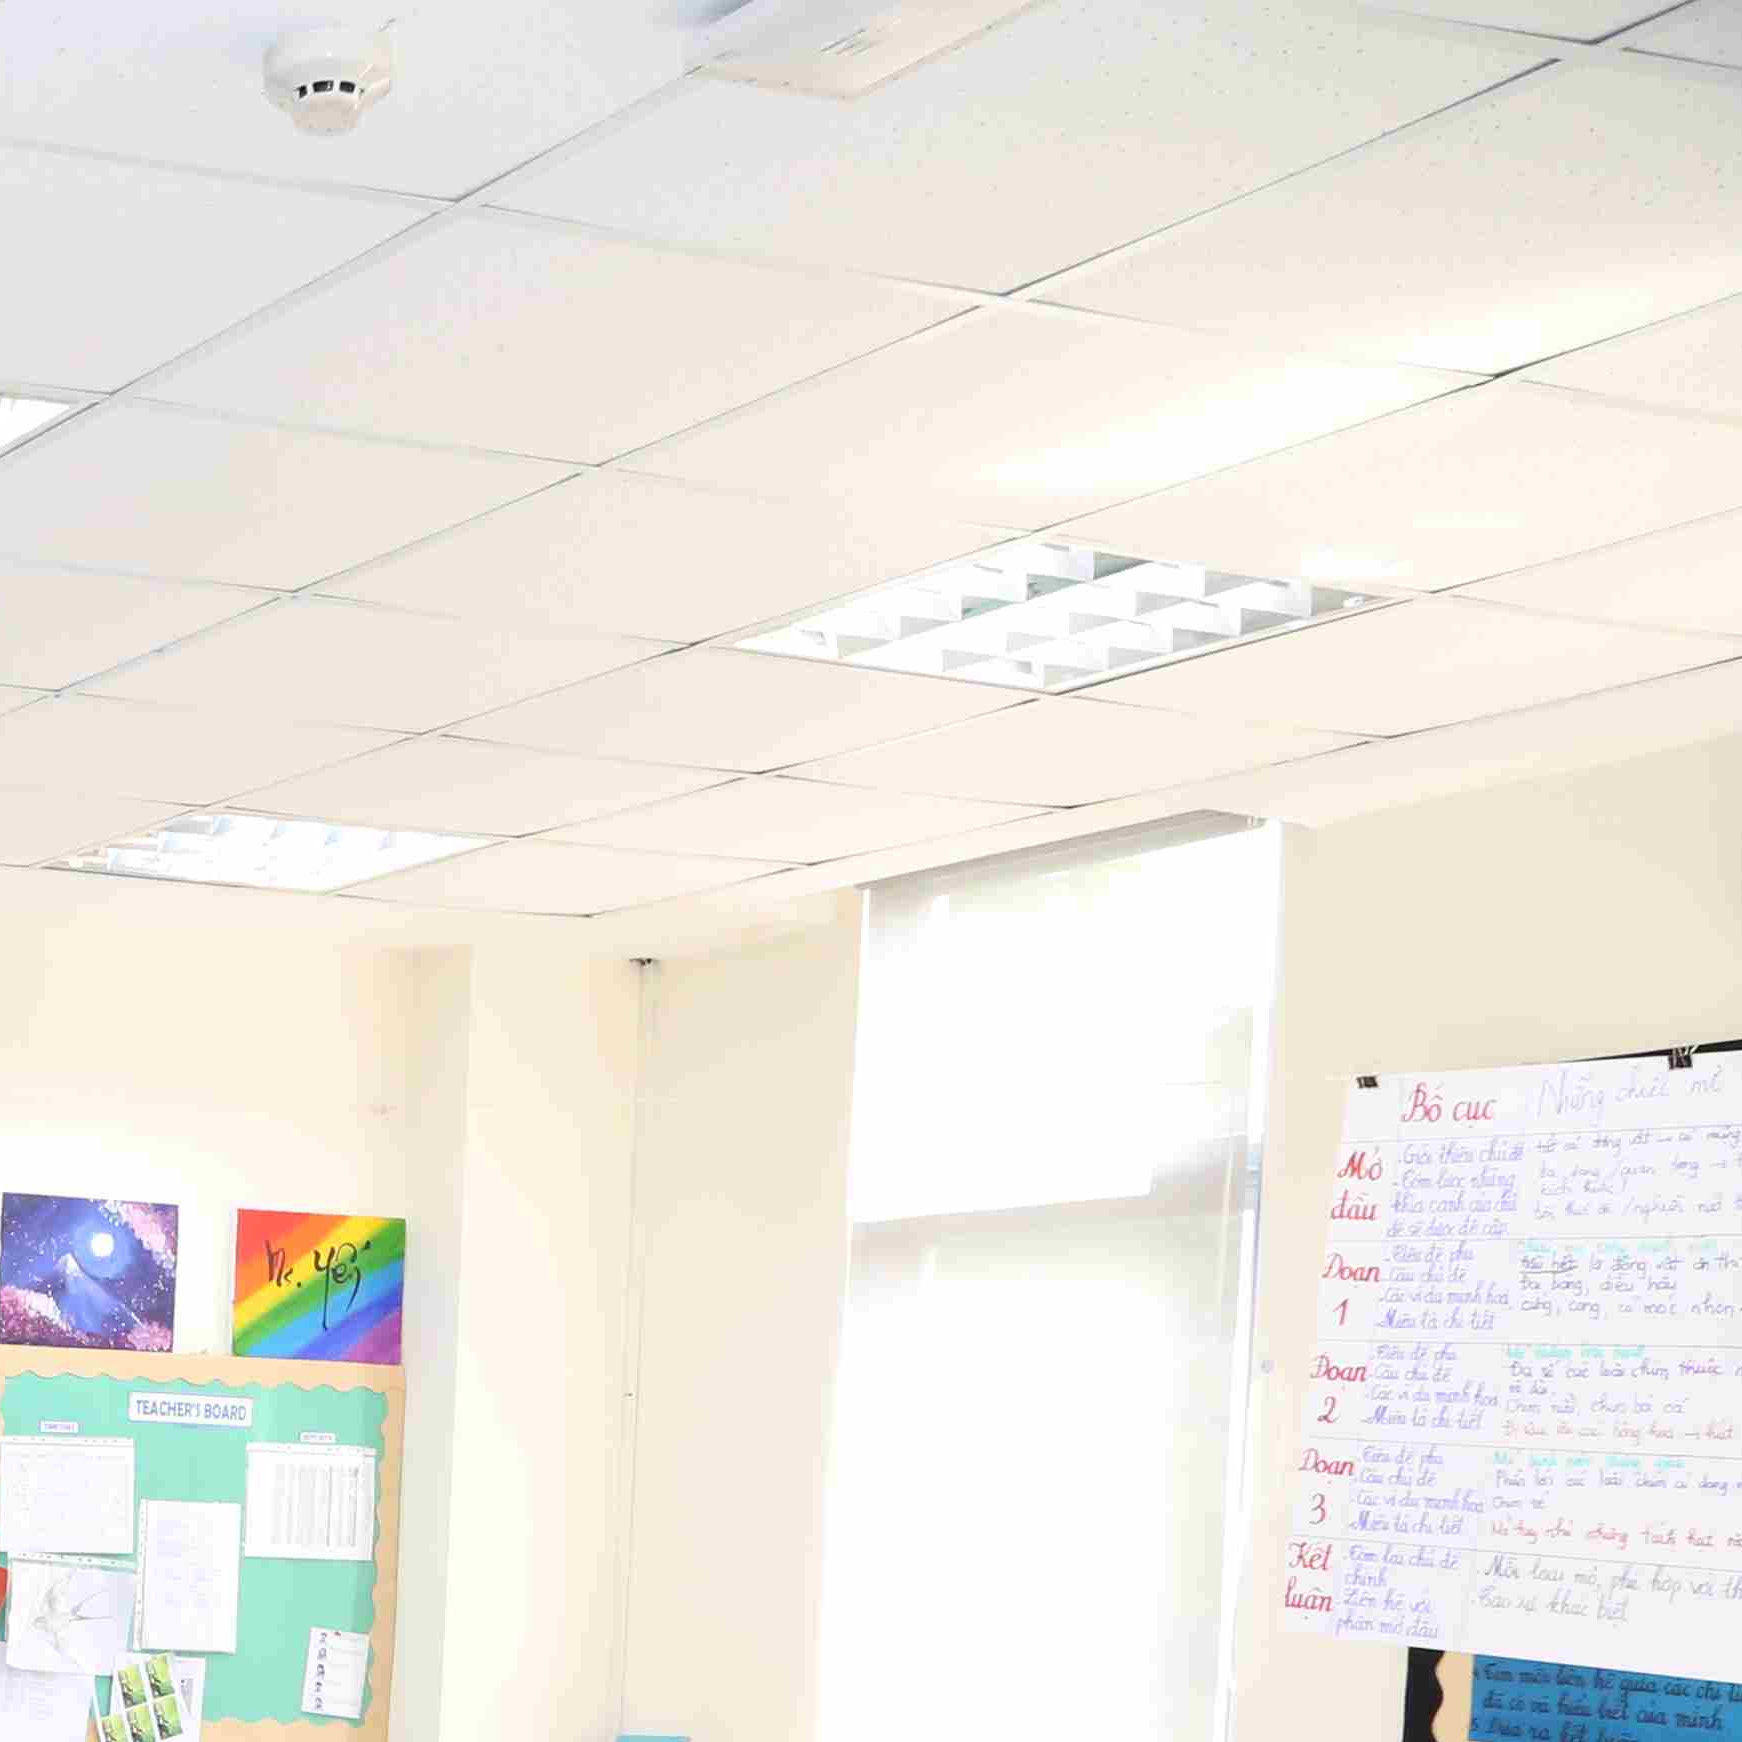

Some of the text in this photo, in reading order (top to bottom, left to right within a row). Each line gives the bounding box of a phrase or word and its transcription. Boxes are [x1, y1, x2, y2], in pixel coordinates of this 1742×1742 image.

[1332, 1297, 1349, 1326] 1
[136, 1400, 246, 1420] TEACHER'S BOARD
[1317, 1396, 1340, 1424] 2
[1309, 1493, 1326, 1525] 3
